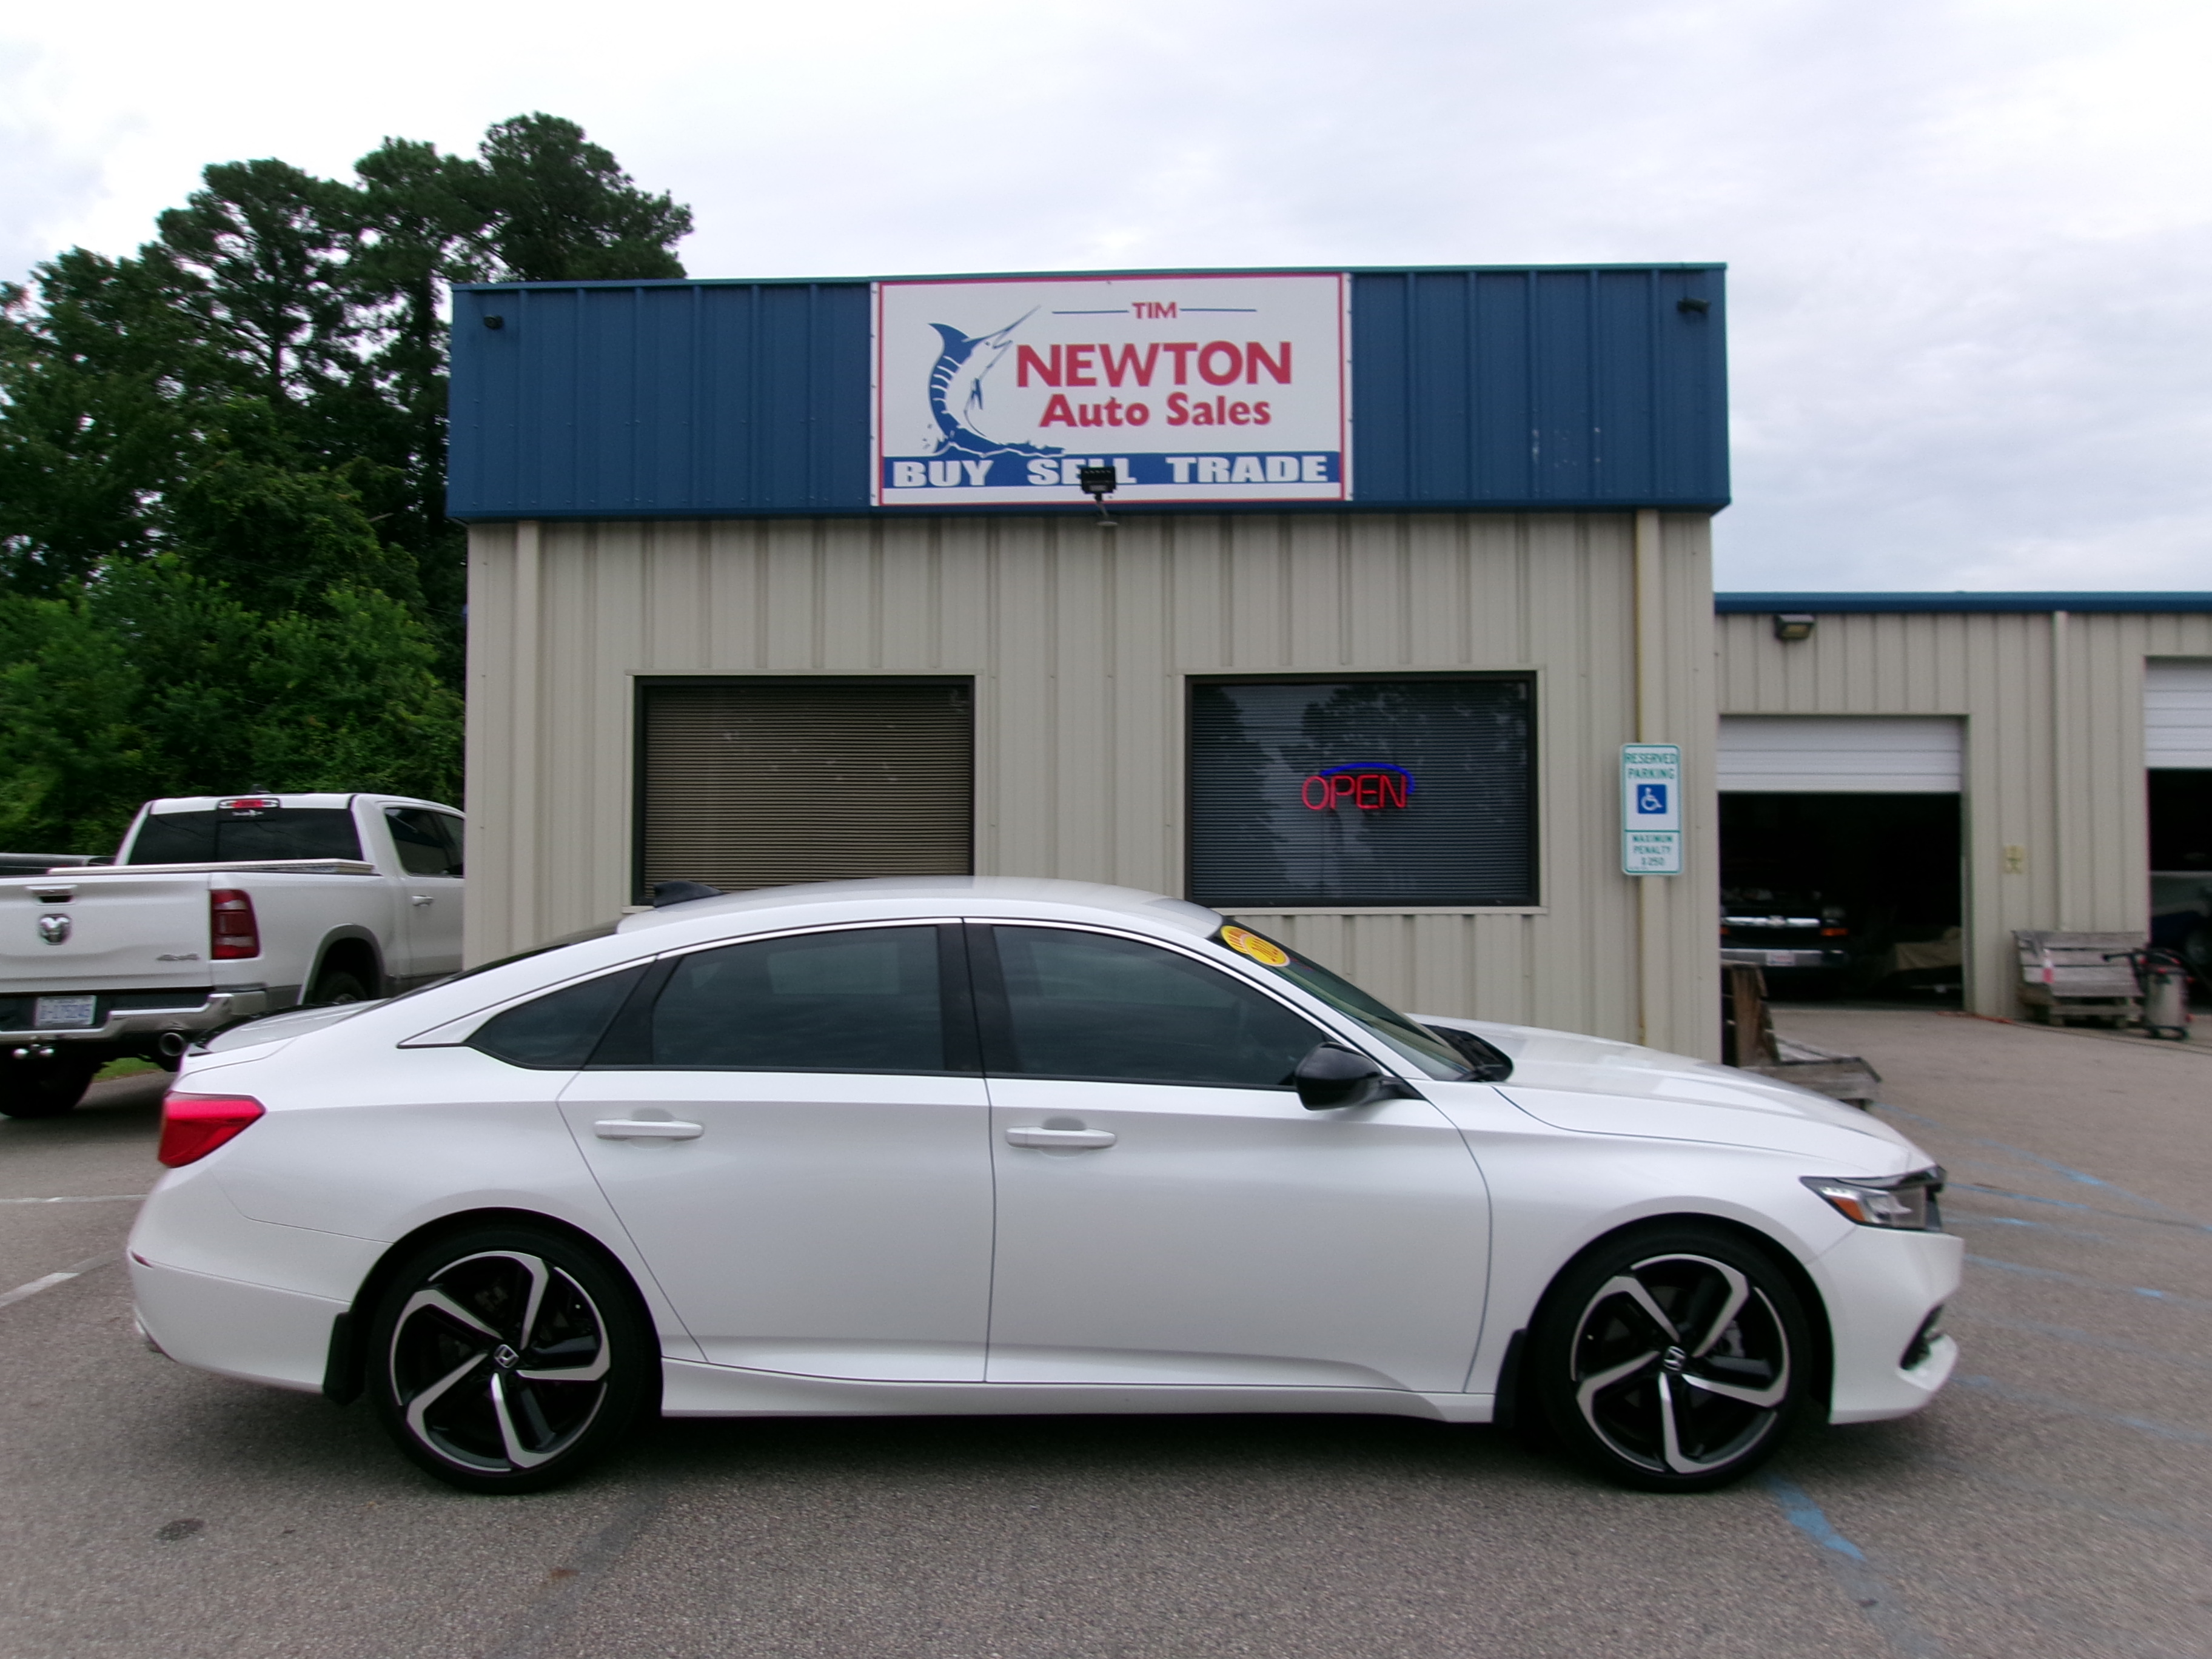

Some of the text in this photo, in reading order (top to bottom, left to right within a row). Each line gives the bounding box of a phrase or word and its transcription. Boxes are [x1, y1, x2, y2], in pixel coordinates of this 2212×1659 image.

[1132, 302, 1178, 320] TIM
[1016, 341, 1292, 387] NEWTON
[1039, 392, 1272, 427] Auto Sales
[893, 459, 994, 488] BUY
[1165, 455, 1329, 483] TRADE
[1625, 753, 1678, 763] RESERVED
[1628, 768, 1675, 779] PARKING
[1301, 774, 1409, 810] OPEN
[1634, 845, 1671, 854] PENALTY
